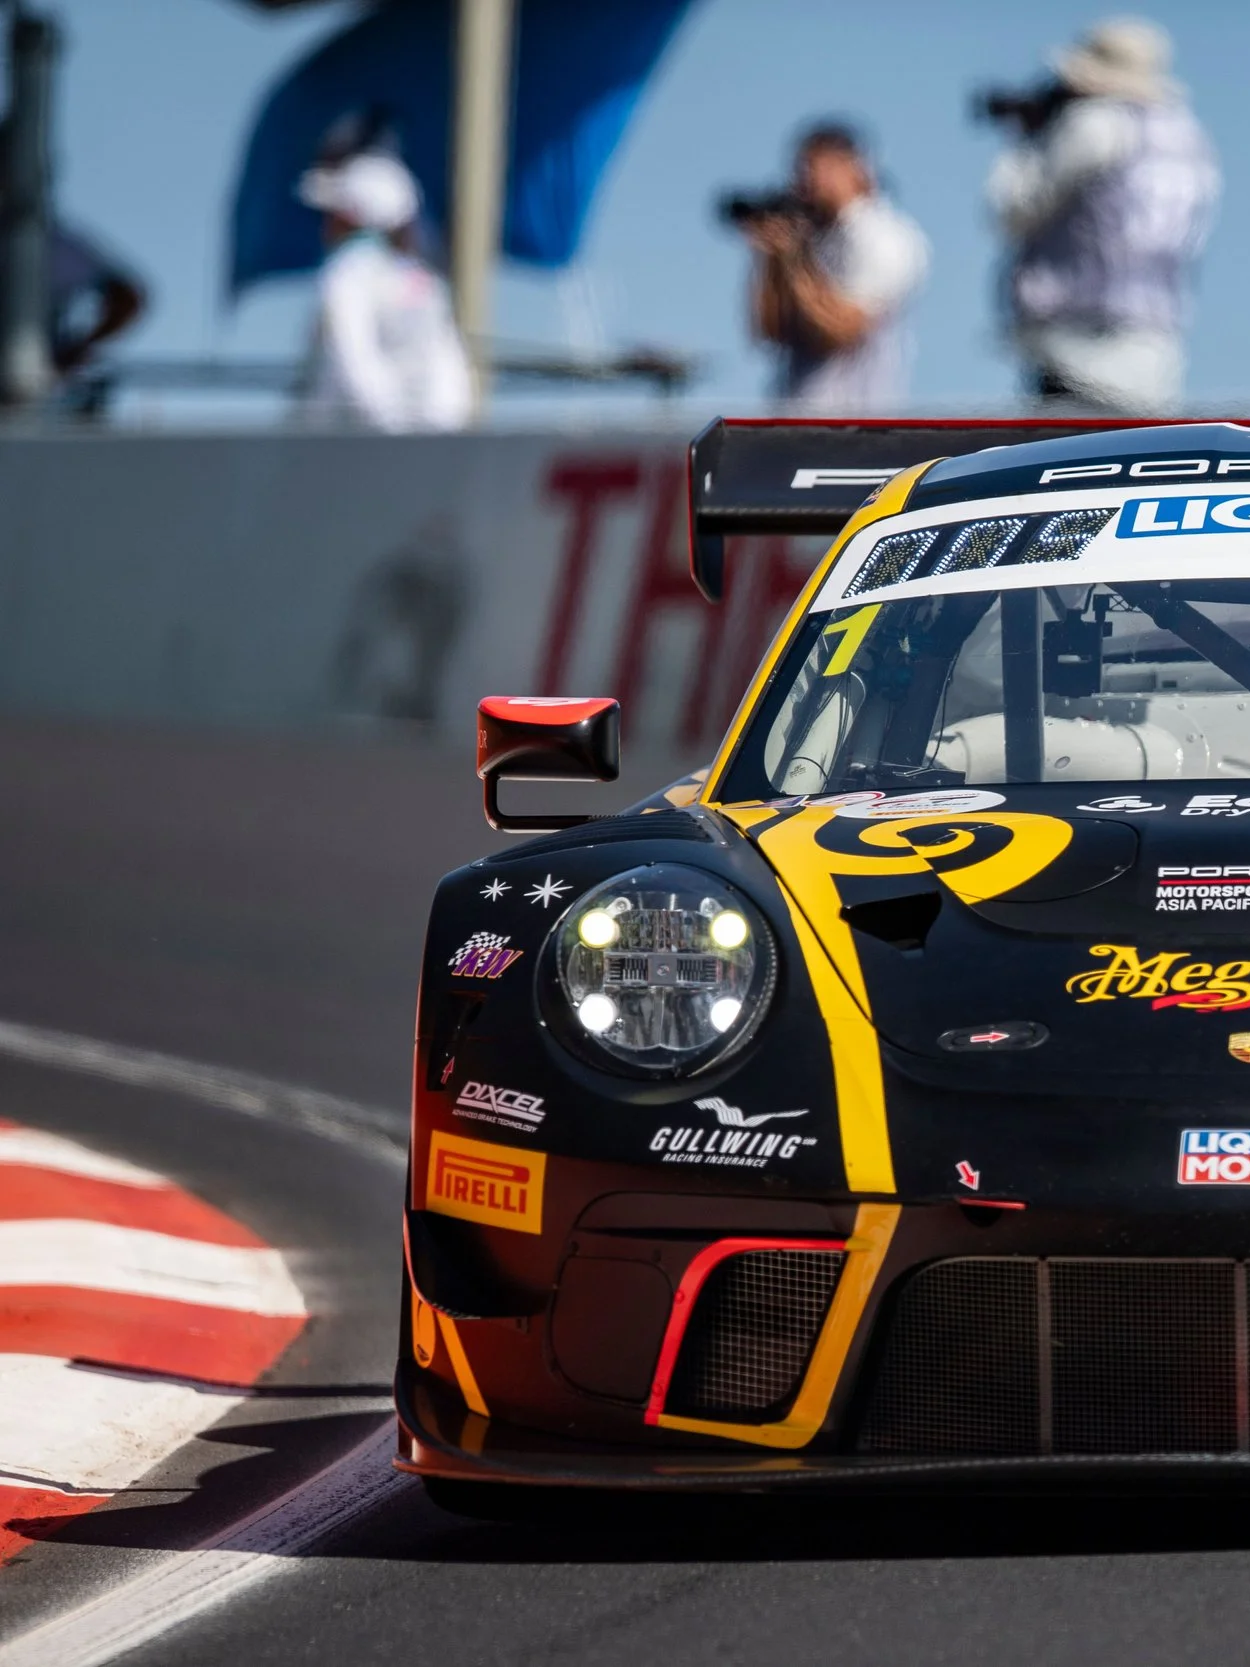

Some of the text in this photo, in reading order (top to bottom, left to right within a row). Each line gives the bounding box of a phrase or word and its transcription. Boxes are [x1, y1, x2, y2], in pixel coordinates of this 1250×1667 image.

[823, 603, 882, 676] 1
[1155, 898, 1197, 911] ASIA
[451, 946, 524, 979] KW
[460, 1081, 546, 1117] DIXCEL
[649, 1127, 802, 1159] GULLWING
[662, 1153, 768, 1168] RACING INSURANCE
[435, 1148, 530, 1215] PIRELLI
